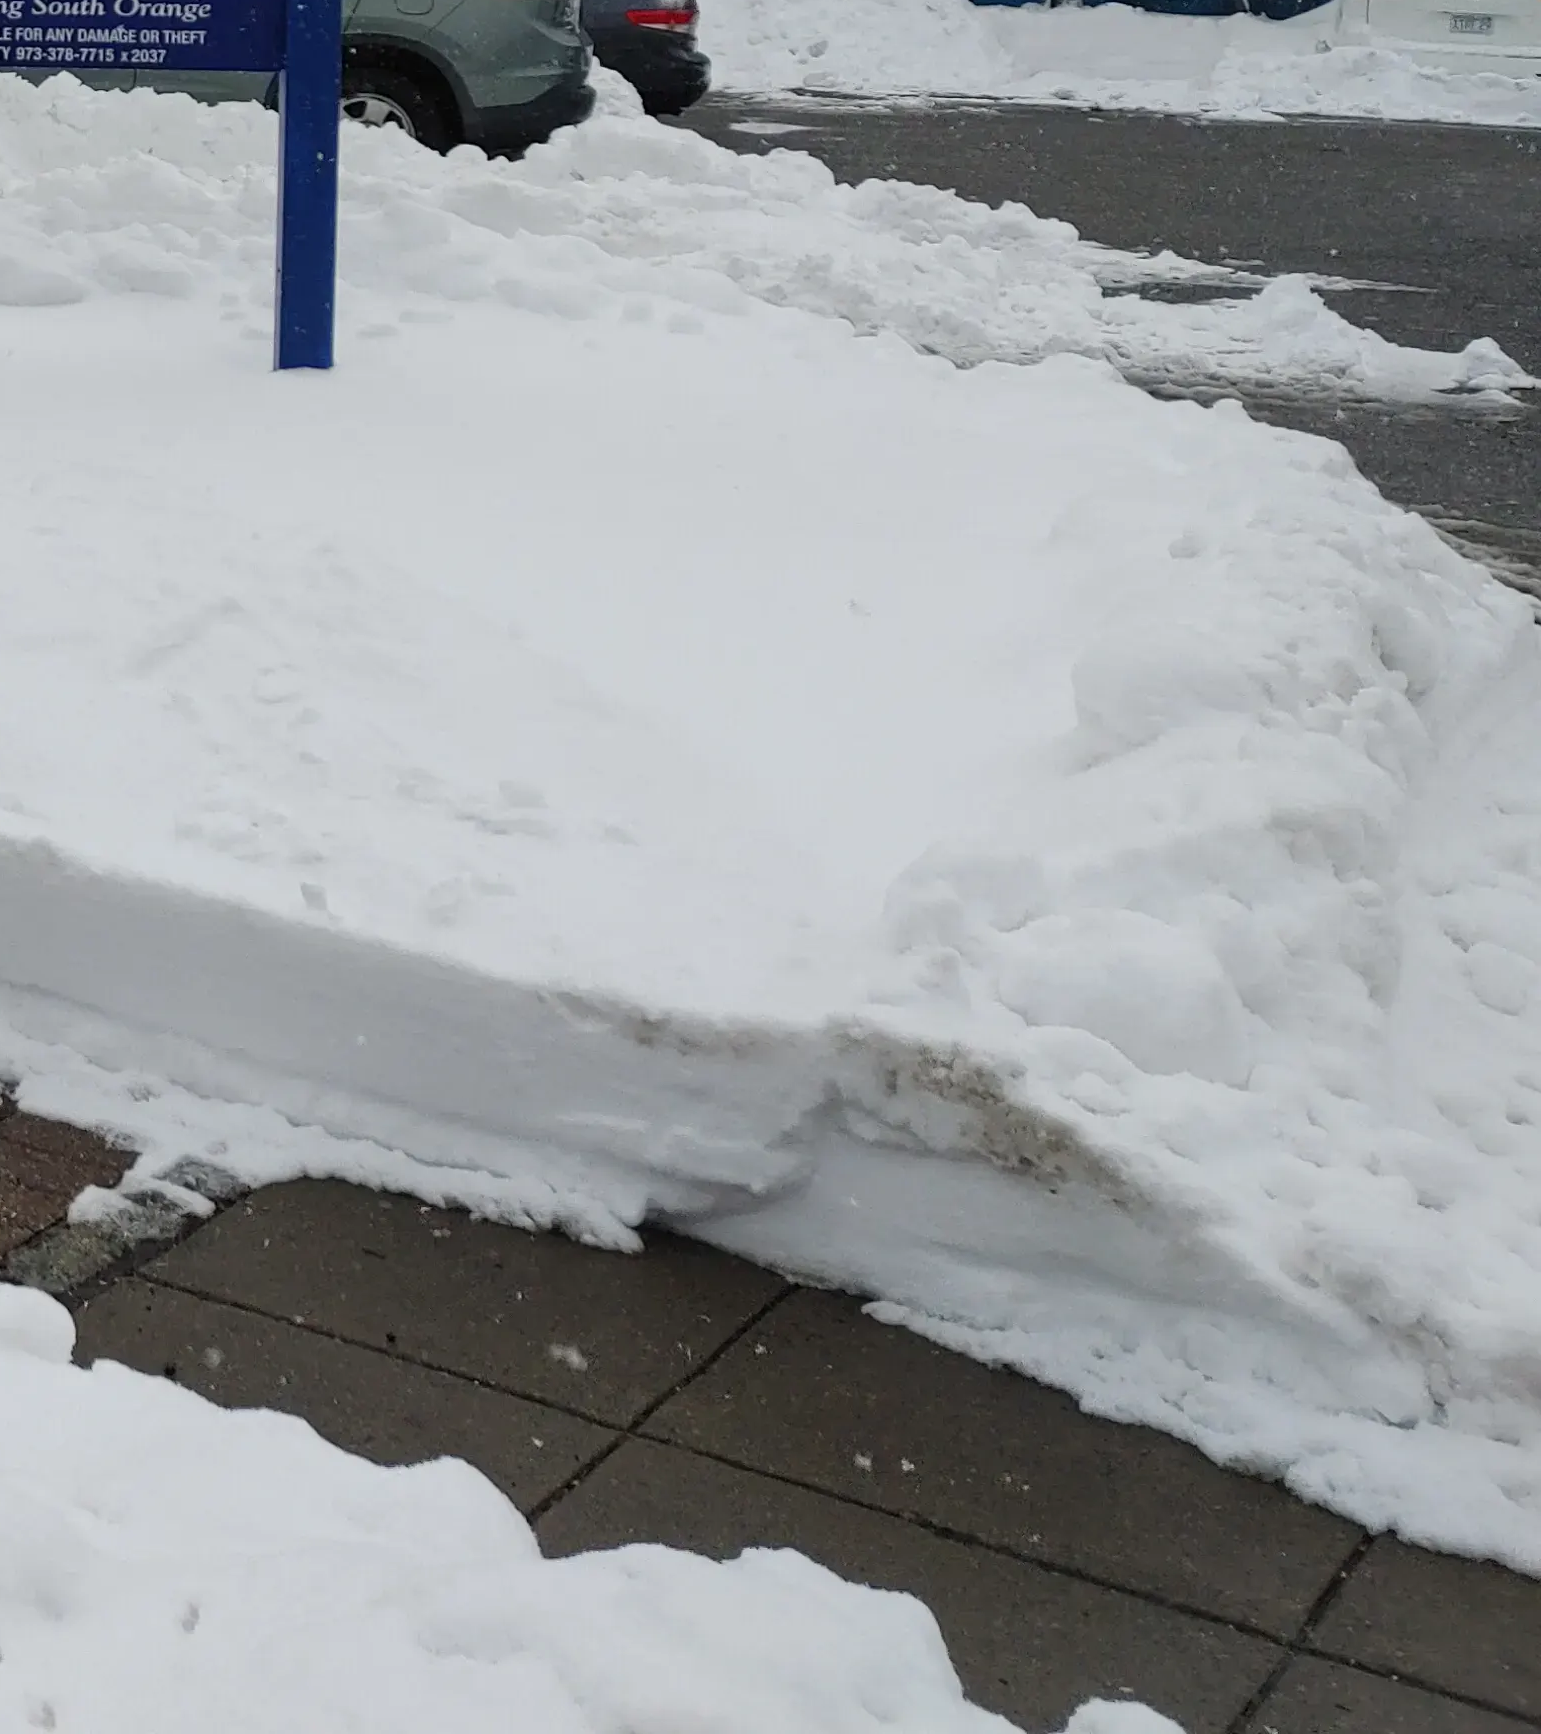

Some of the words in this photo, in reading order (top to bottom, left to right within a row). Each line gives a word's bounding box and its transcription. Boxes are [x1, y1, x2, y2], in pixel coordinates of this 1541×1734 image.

[16, 26, 43, 41] FOR
[45, 27, 74, 42] ANY
[77, 28, 137, 43] DAMAGE
[140, 29, 160, 44] OR
[163, 30, 207, 45] THEFT
[16, 46, 114, 62] 973-378-7715
